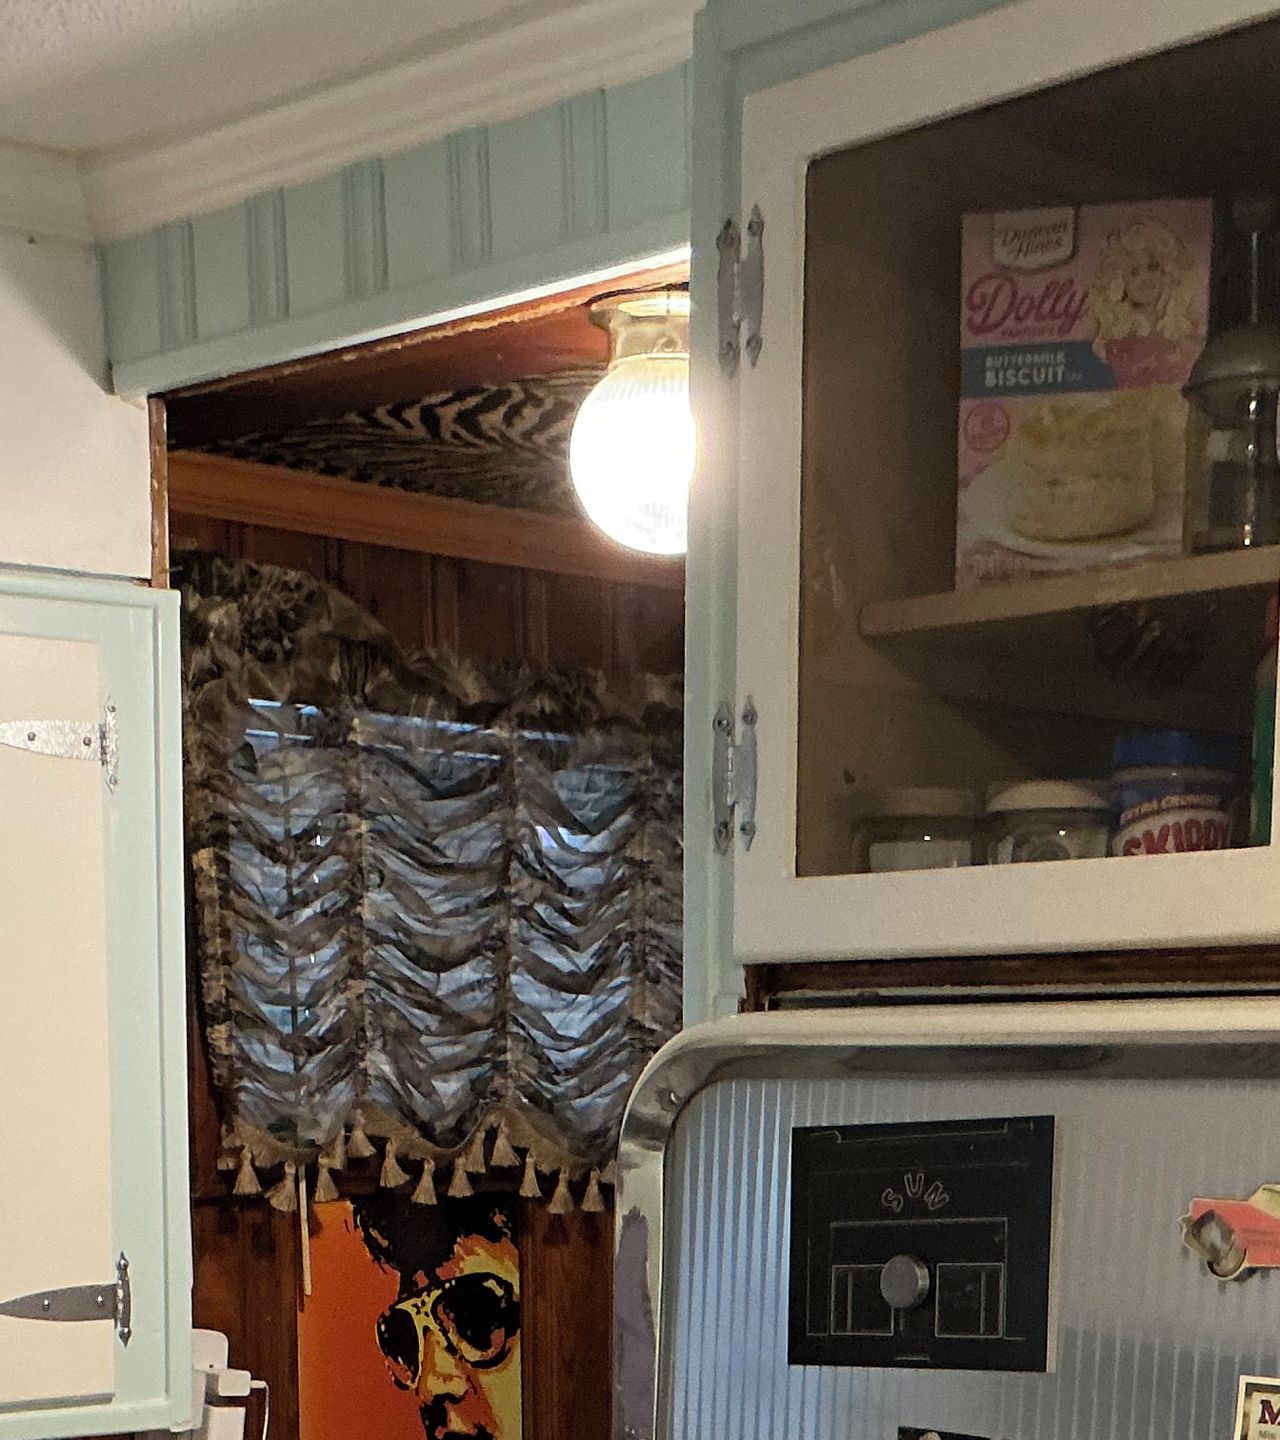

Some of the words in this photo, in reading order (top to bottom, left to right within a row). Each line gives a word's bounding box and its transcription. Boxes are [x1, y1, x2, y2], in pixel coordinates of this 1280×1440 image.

[967, 272, 1089, 335] Dolly
[985, 366, 1066, 388] BISCUIT
[881, 1172, 949, 1213] SUN
